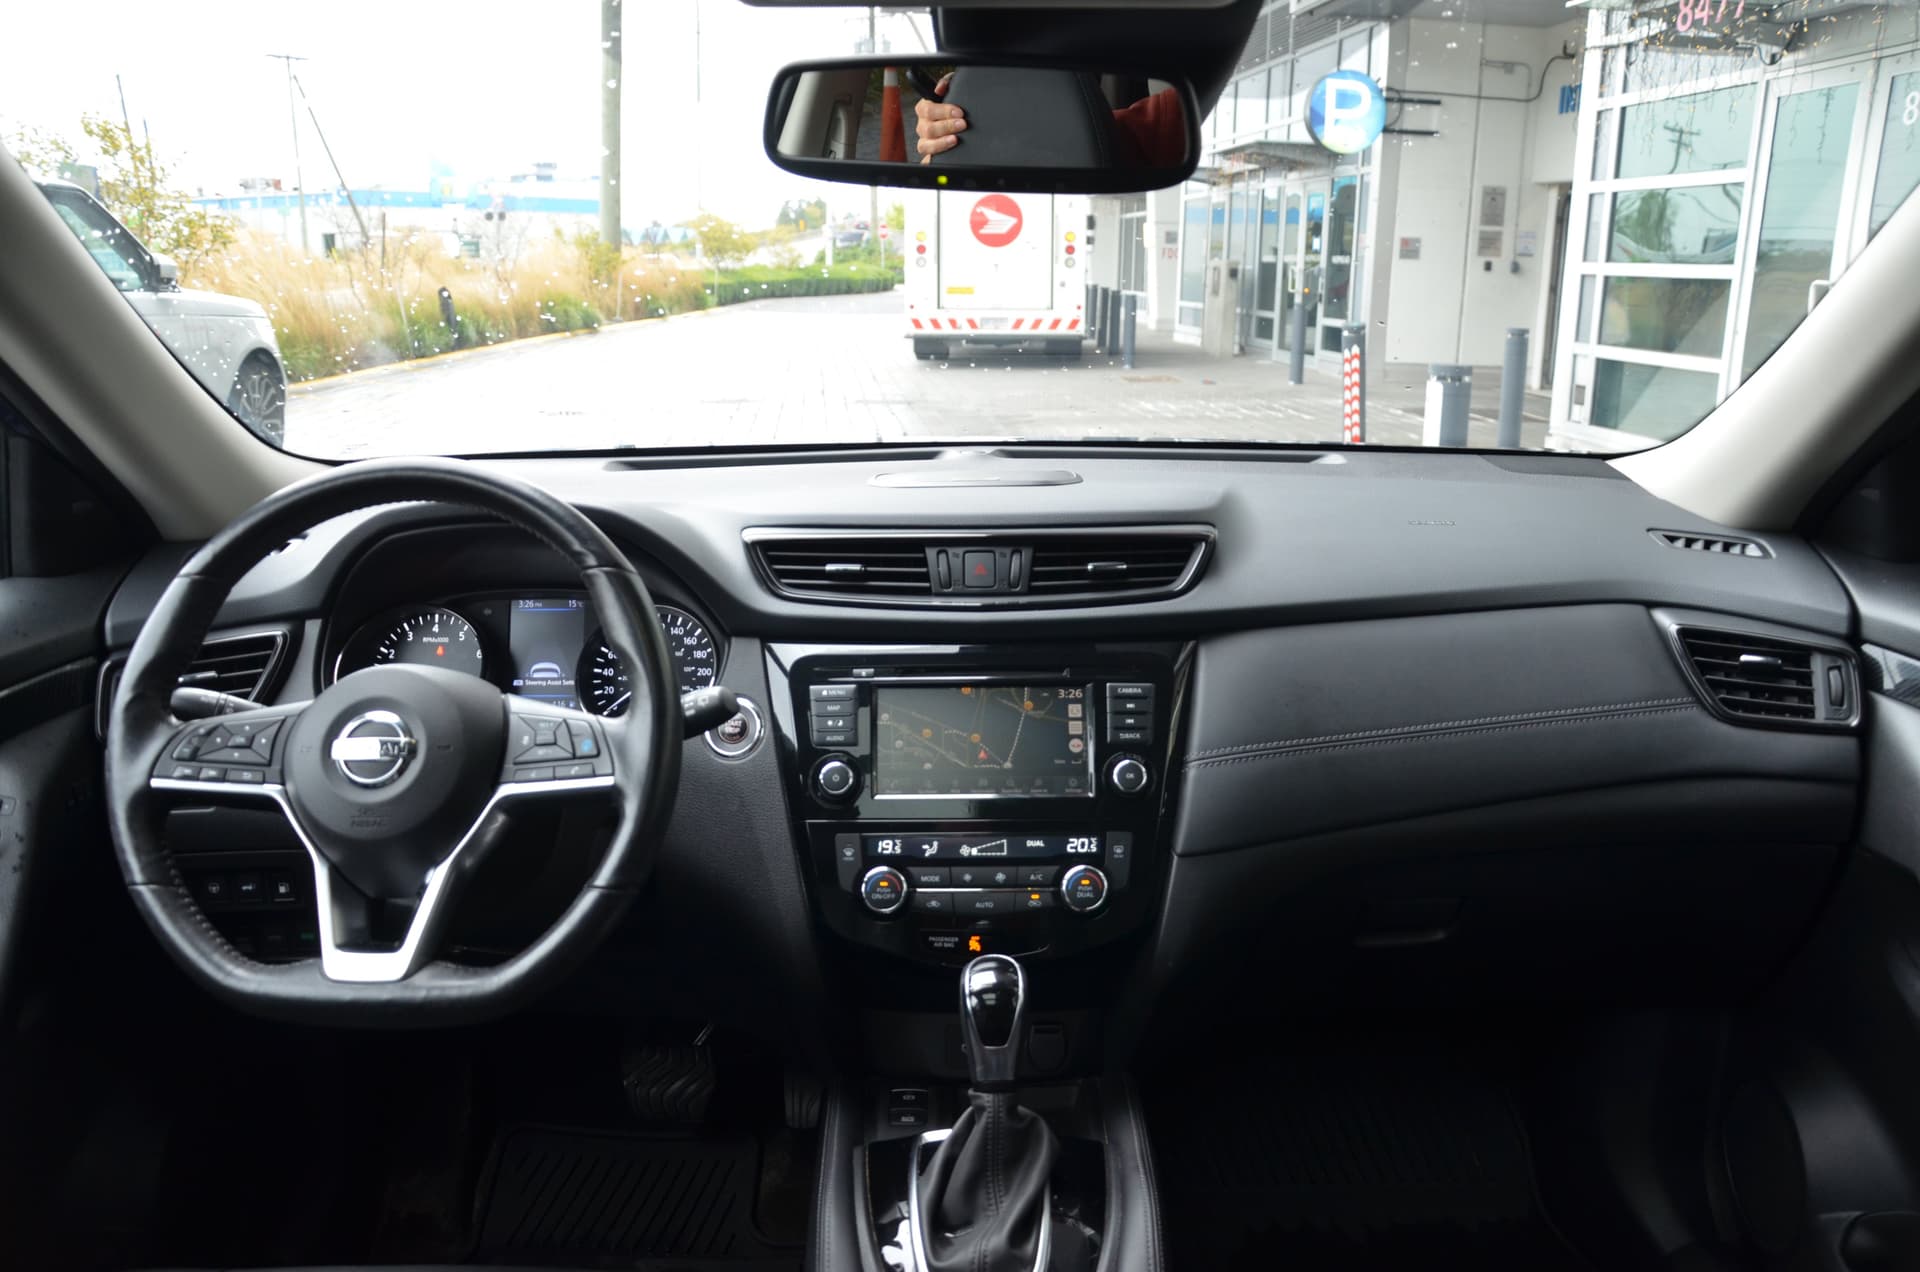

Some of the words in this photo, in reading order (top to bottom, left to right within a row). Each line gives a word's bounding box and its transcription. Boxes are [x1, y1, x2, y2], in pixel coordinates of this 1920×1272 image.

[1323, 78, 1371, 140] P
[518, 600, 534, 608] 3:26
[568, 600, 577, 608] 15
[432, 624, 439, 633] 4
[670, 627, 684, 635] 140
[407, 632, 413, 641] 3
[459, 632, 465, 641] 5
[683, 637, 697, 645] 160
[389, 650, 395, 658] 2
[602, 668, 614, 676] 40
[697, 668, 712, 676] 200
[1057, 689, 1083, 699] 3:26
